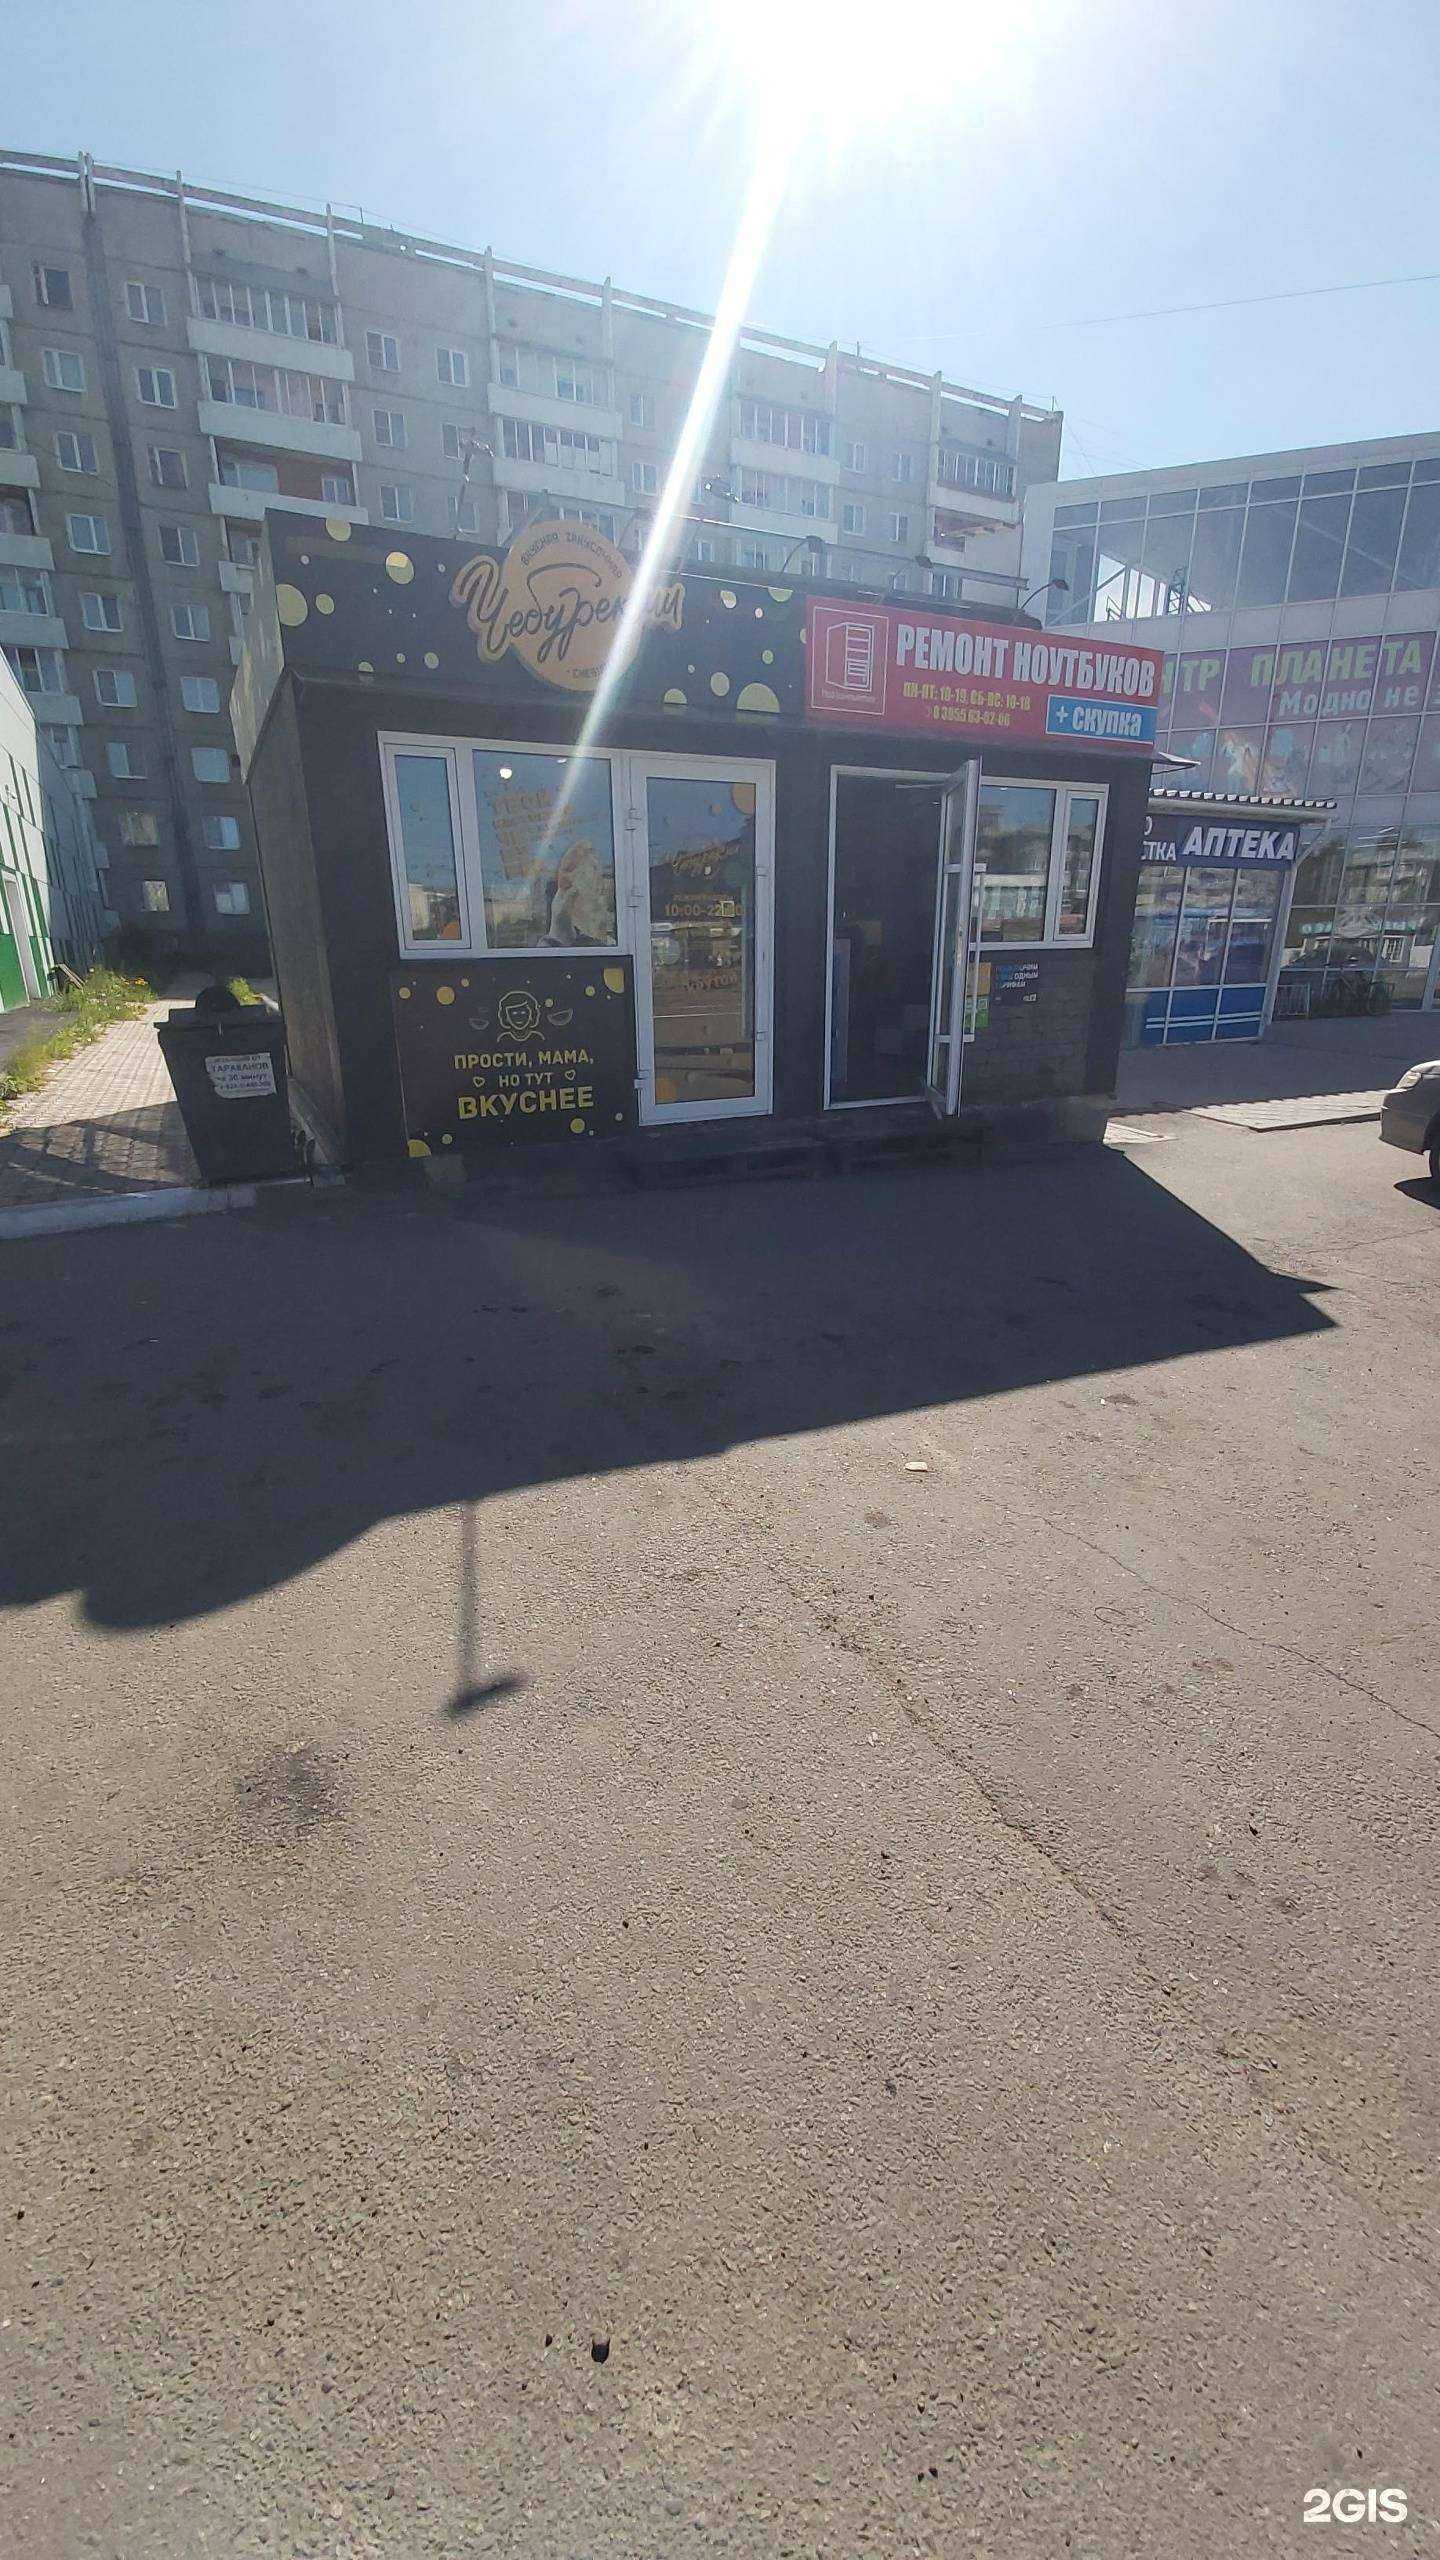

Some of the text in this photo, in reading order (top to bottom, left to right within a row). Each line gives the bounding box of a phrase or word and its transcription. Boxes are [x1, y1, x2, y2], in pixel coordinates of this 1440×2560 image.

[897, 623, 1156, 698] РЕМОНТ НОУТБУКОВ
[1250, 640, 1421, 687] ПЛАНЕТА
[1181, 826, 1296, 860] АПТЕКА
[454, 1049, 594, 1069] ПРОСТИ, МАМА,
[499, 1072, 553, 1088] НО ТУТ
[458, 1085, 594, 1120] ВКУСНЕЕ
